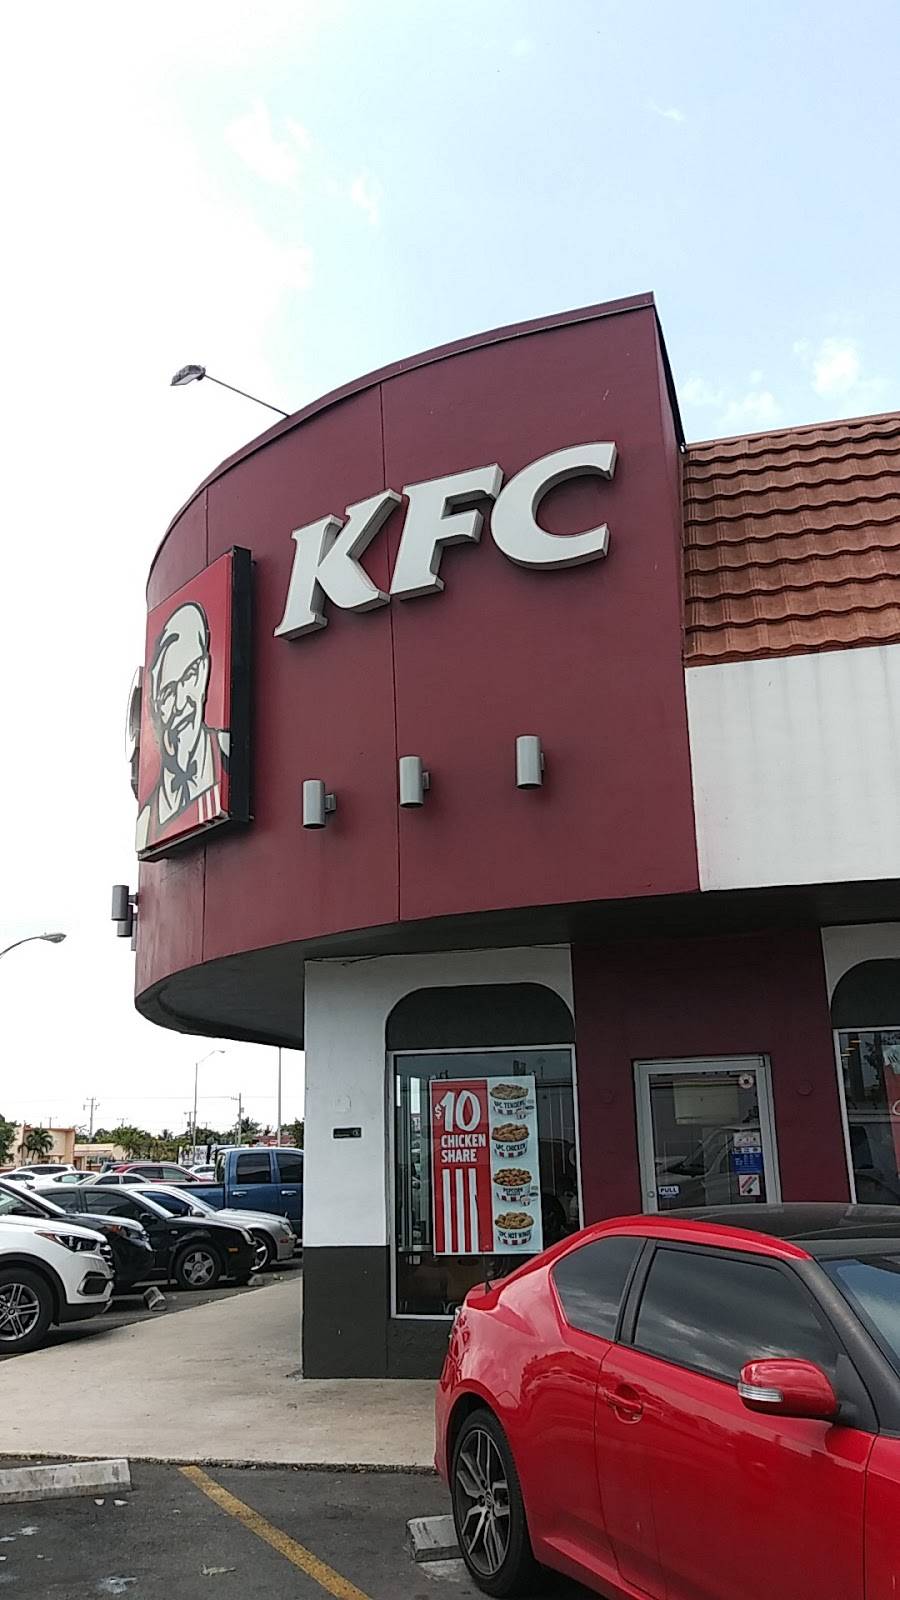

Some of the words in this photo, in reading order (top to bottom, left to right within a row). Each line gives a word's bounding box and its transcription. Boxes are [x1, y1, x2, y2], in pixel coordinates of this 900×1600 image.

[274, 441, 616, 640] KFC
[434, 1089, 481, 1132] $10
[441, 1133, 487, 1148] CHICKEN
[506, 1143, 526, 1152] CHICKEN
[441, 1148, 478, 1163] SHARE
